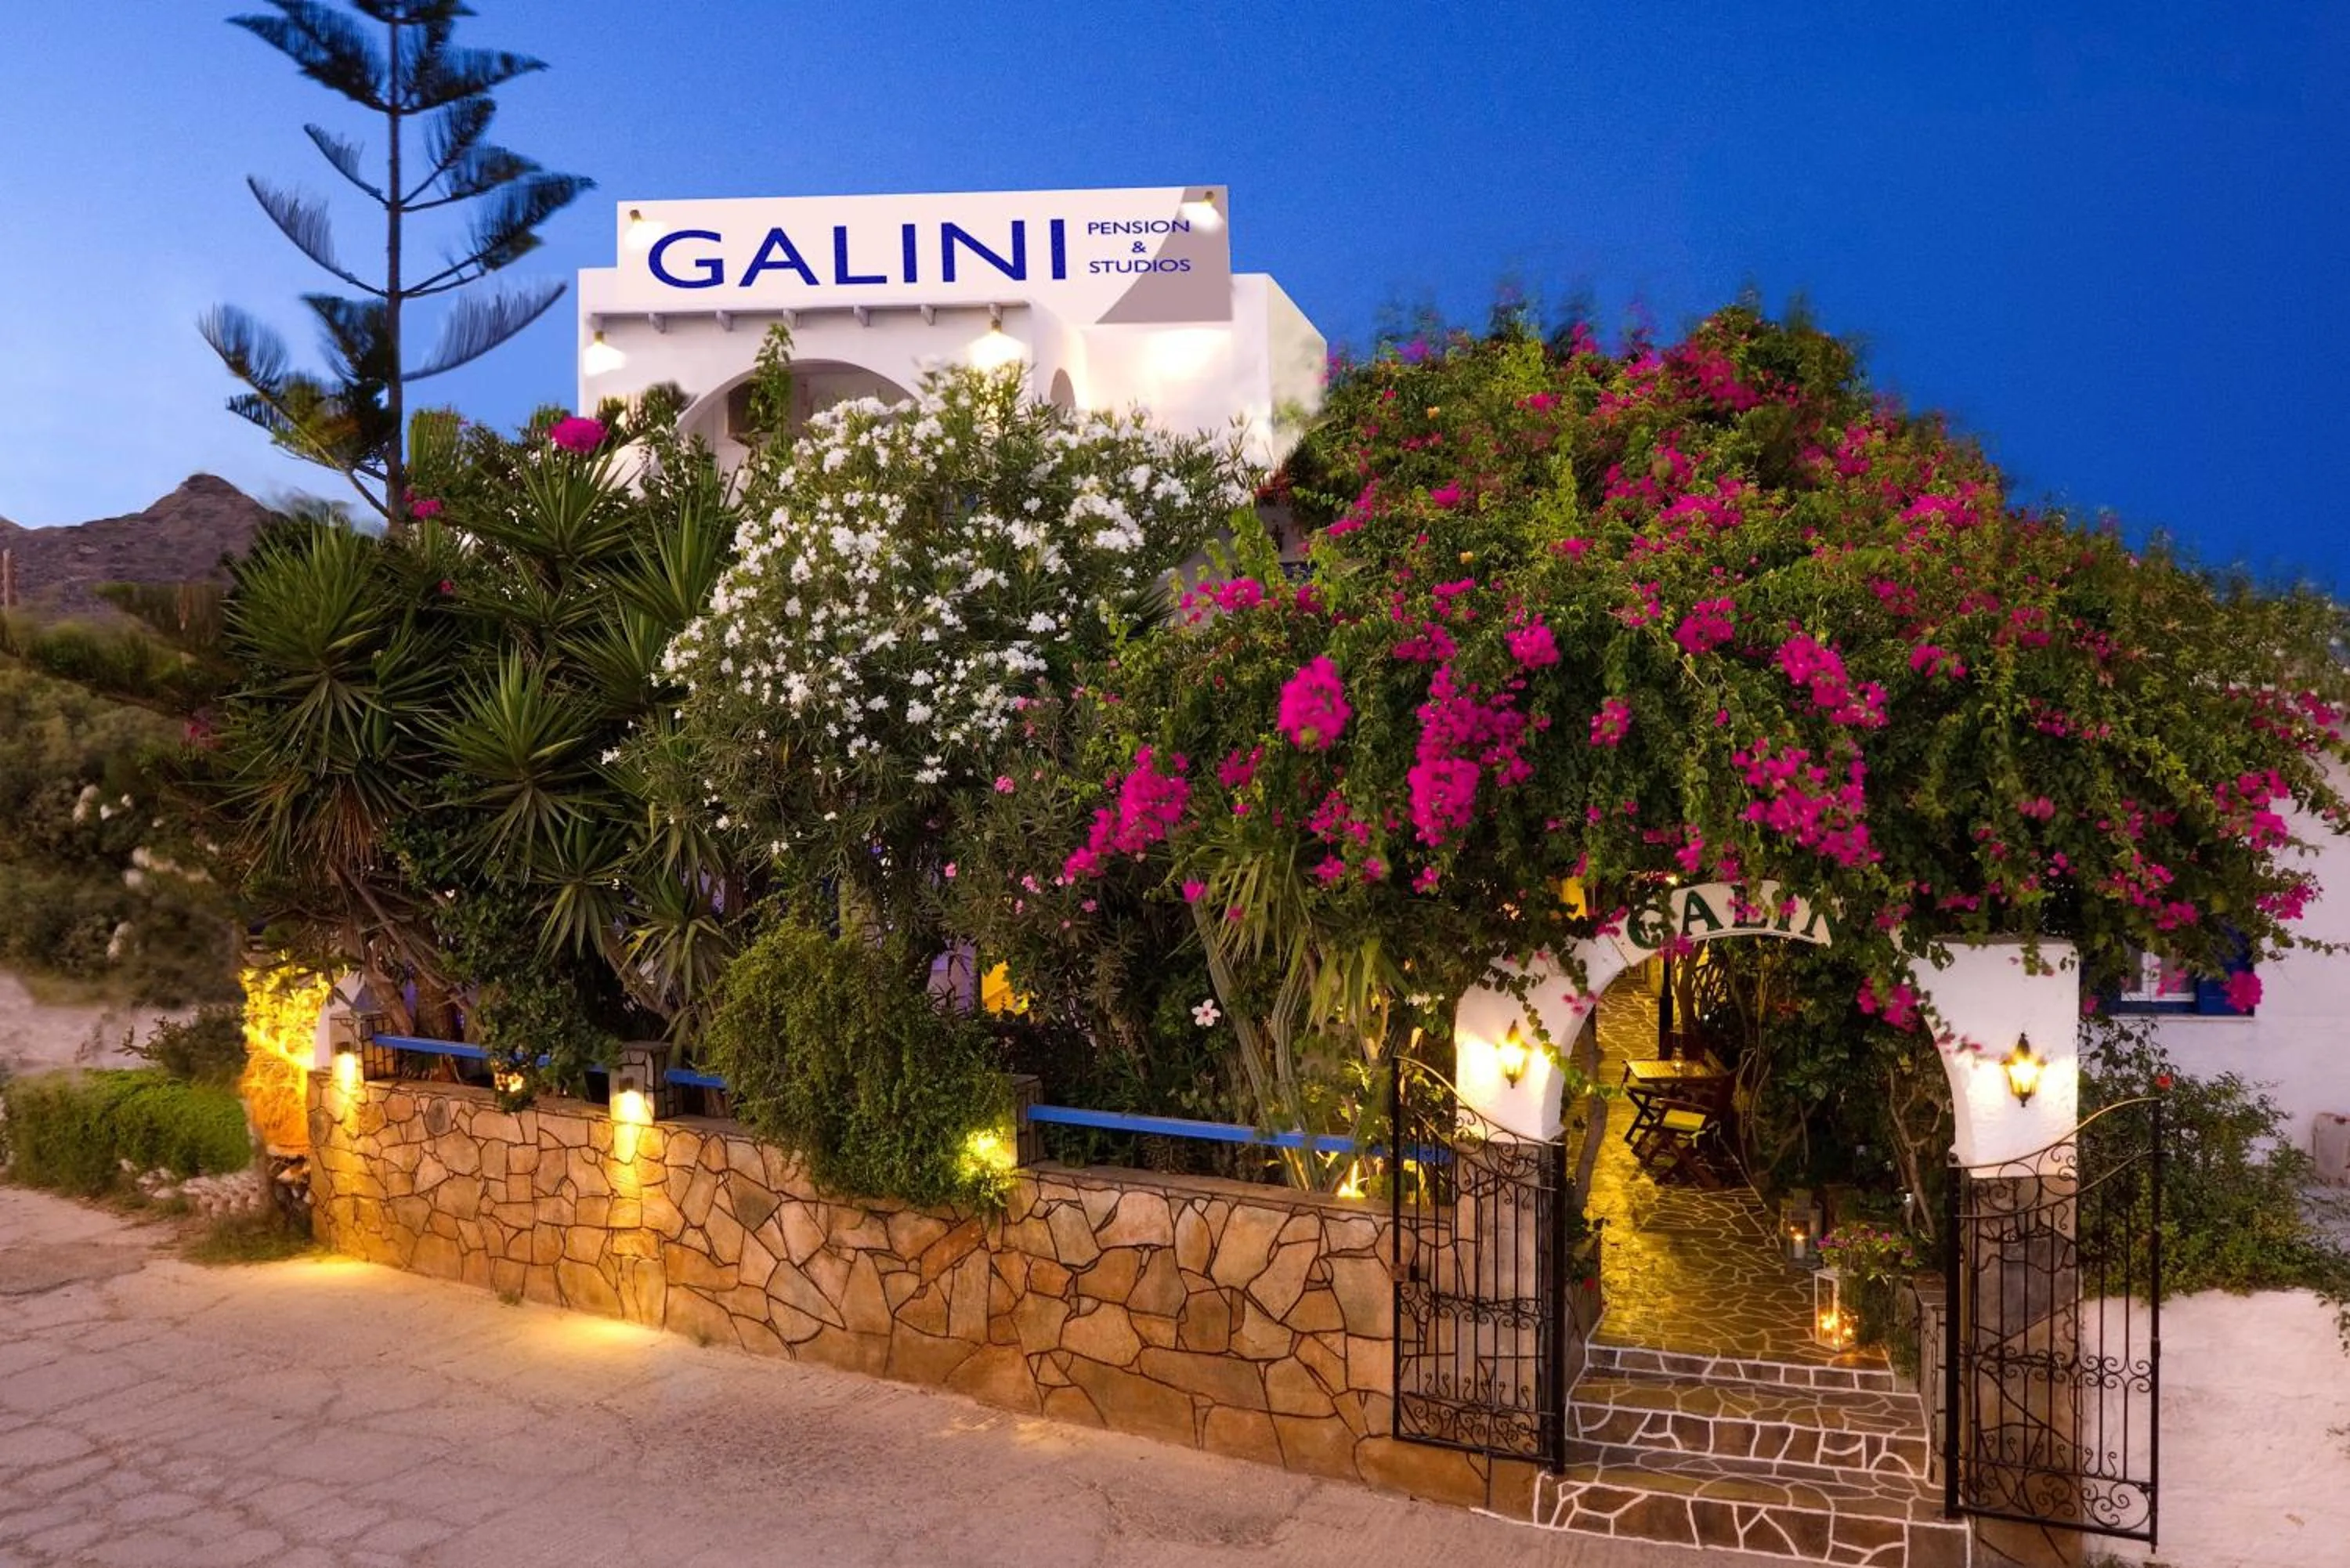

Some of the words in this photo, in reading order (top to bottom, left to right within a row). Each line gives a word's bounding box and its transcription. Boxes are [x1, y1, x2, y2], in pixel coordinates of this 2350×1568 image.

[1088, 219, 1190, 235] PENSION
[648, 219, 1066, 289] GALINI
[1132, 240, 1146, 253] &
[1090, 258, 1191, 273] STUDIOS
